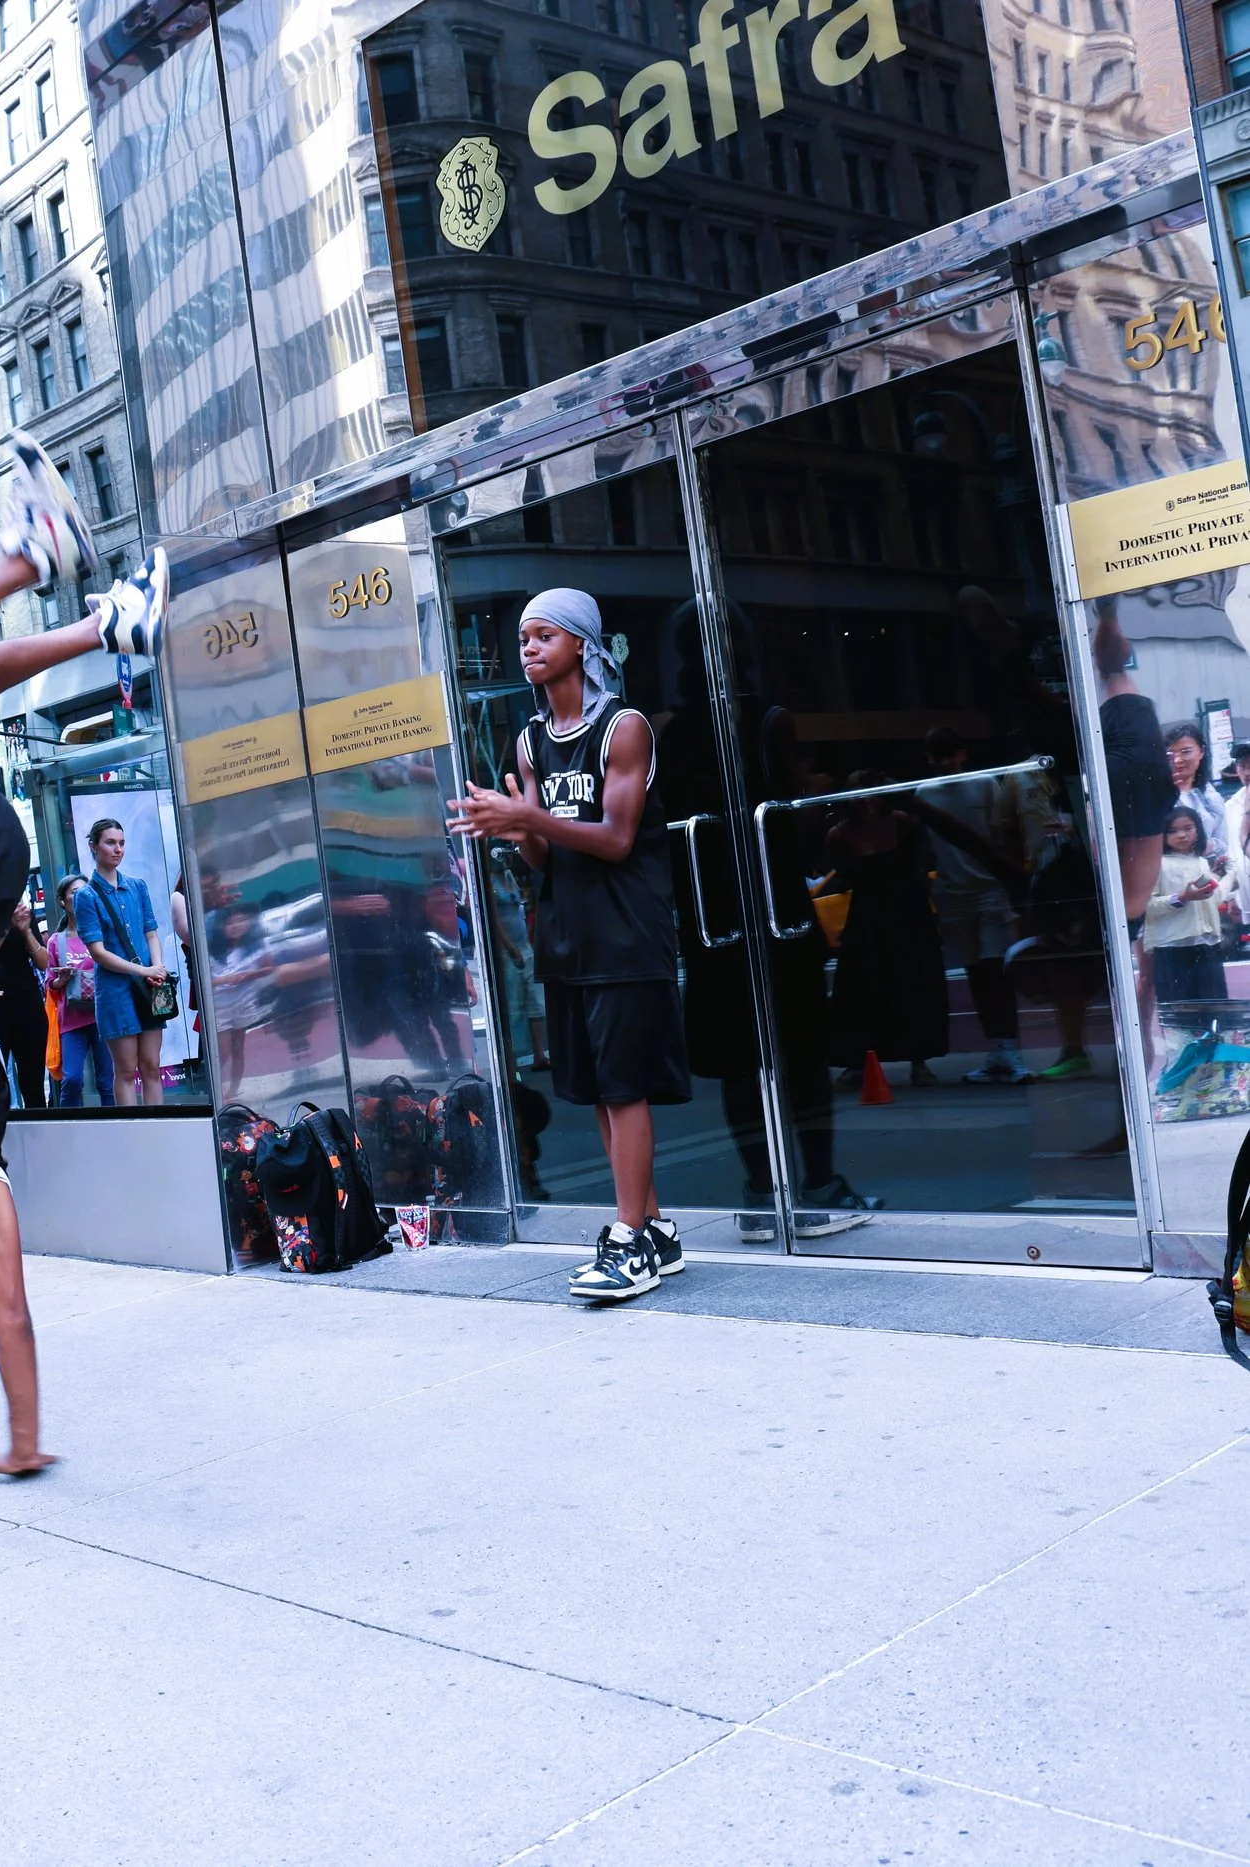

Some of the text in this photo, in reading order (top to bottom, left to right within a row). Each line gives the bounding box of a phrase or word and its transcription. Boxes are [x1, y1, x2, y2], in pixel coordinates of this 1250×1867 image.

[528, 0, 906, 215] Safra
[1176, 494, 1197, 505] Safra
[1198, 486, 1228, 500] National
[1217, 494, 1229, 502] York
[1119, 513, 1245, 551] DOMESTIC PRIVATE
[1105, 542, 1204, 573] INTERNATIONAL
[328, 566, 392, 619] 546
[368, 703, 383, 712] National
[325, 725, 432, 757] INTERNATIONAL PRIVATE BANKING
[332, 714, 422, 742] DOMESTIC PRIVATE BANKING
[566, 773, 595, 804] YOR
